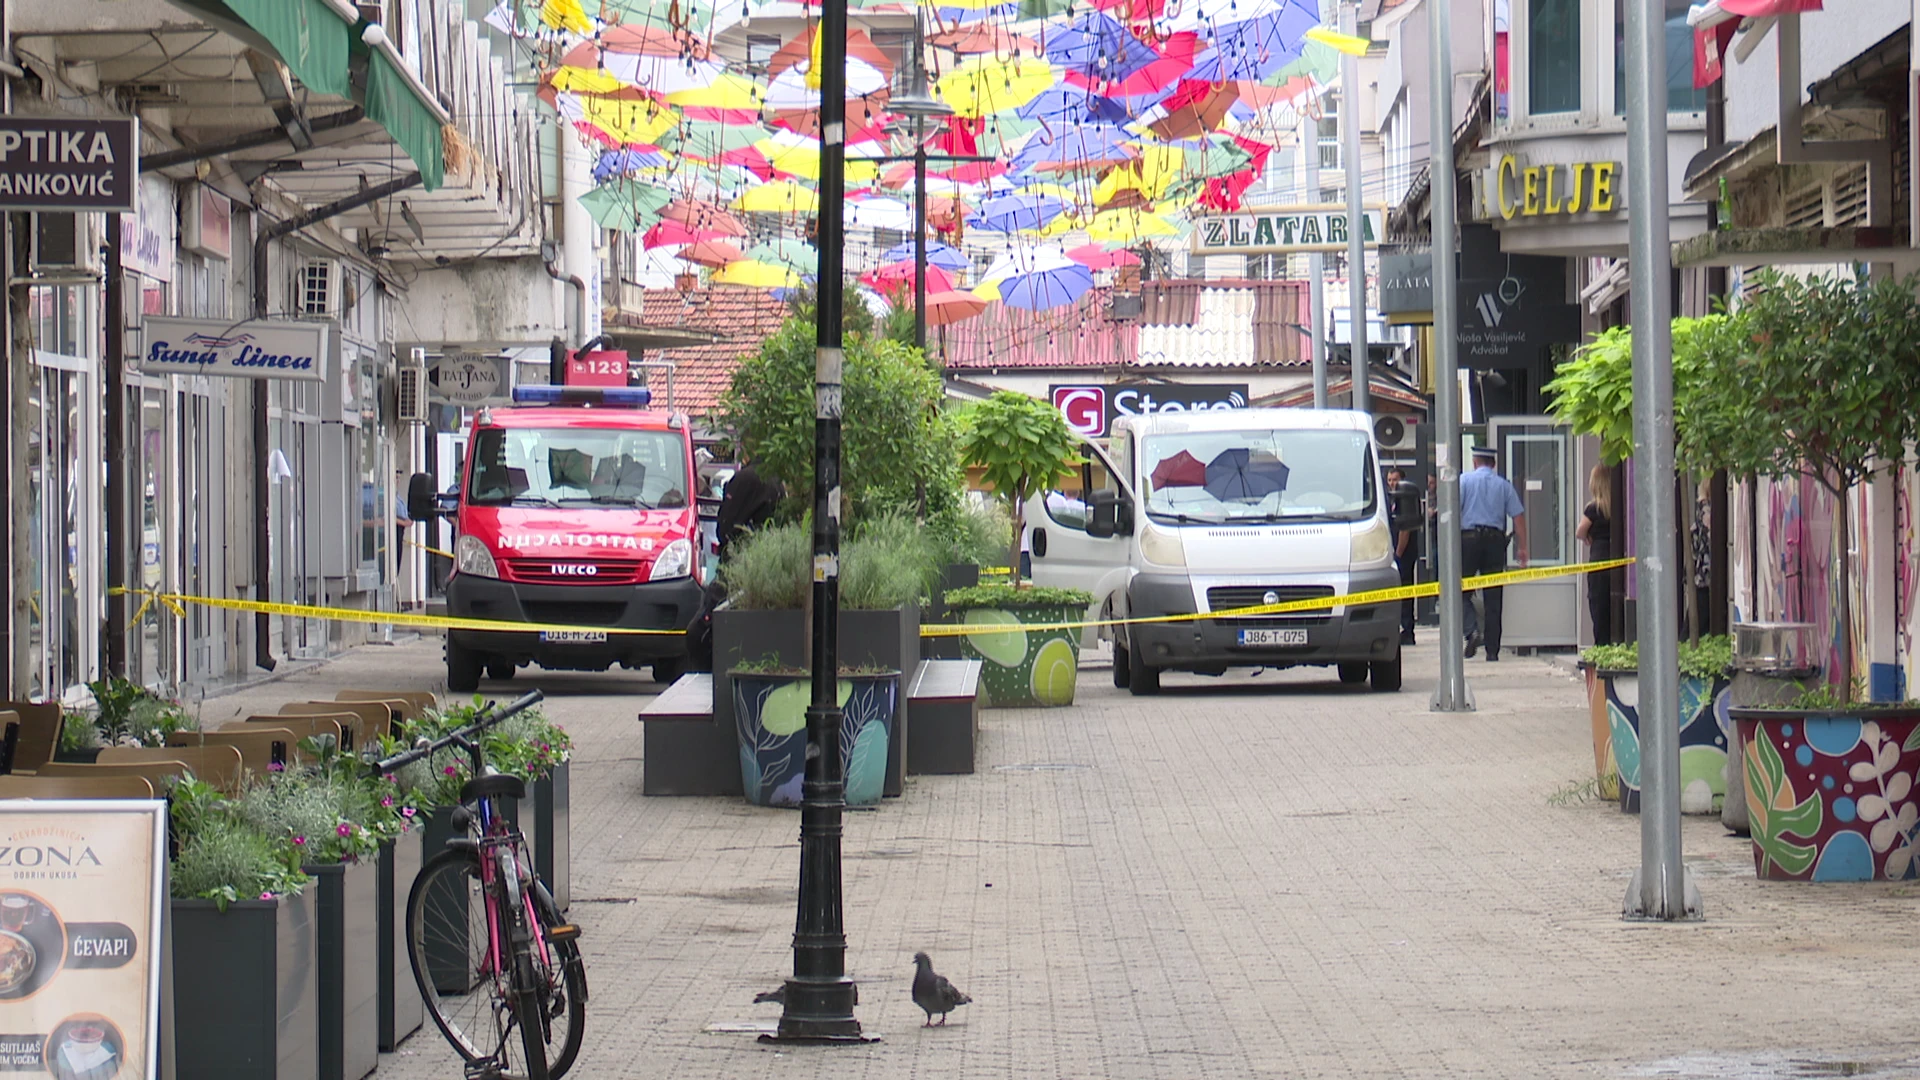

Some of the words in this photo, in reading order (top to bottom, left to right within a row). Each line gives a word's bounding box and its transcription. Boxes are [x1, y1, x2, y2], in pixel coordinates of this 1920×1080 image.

[0, 130, 115, 164] PTIKA
[0, 170, 114, 197] ANKOVIĆ
[1497, 153, 1615, 221] CELJE
[232, 345, 312, 370] Linea
[1470, 344, 1508, 355] Advokat
[588, 360, 623, 375] 123
[441, 368, 496, 390] TATJANA
[455, 391, 482, 399] STUDIO
[1059, 390, 1099, 434] G
[551, 564, 598, 576] IVECO
[1245, 631, 1305, 643] J86-T-075
[13, 871, 46, 880] DOBRIH
[49, 871, 78, 880] UKUSA
[73, 935, 129, 957] ĆEVAPI
